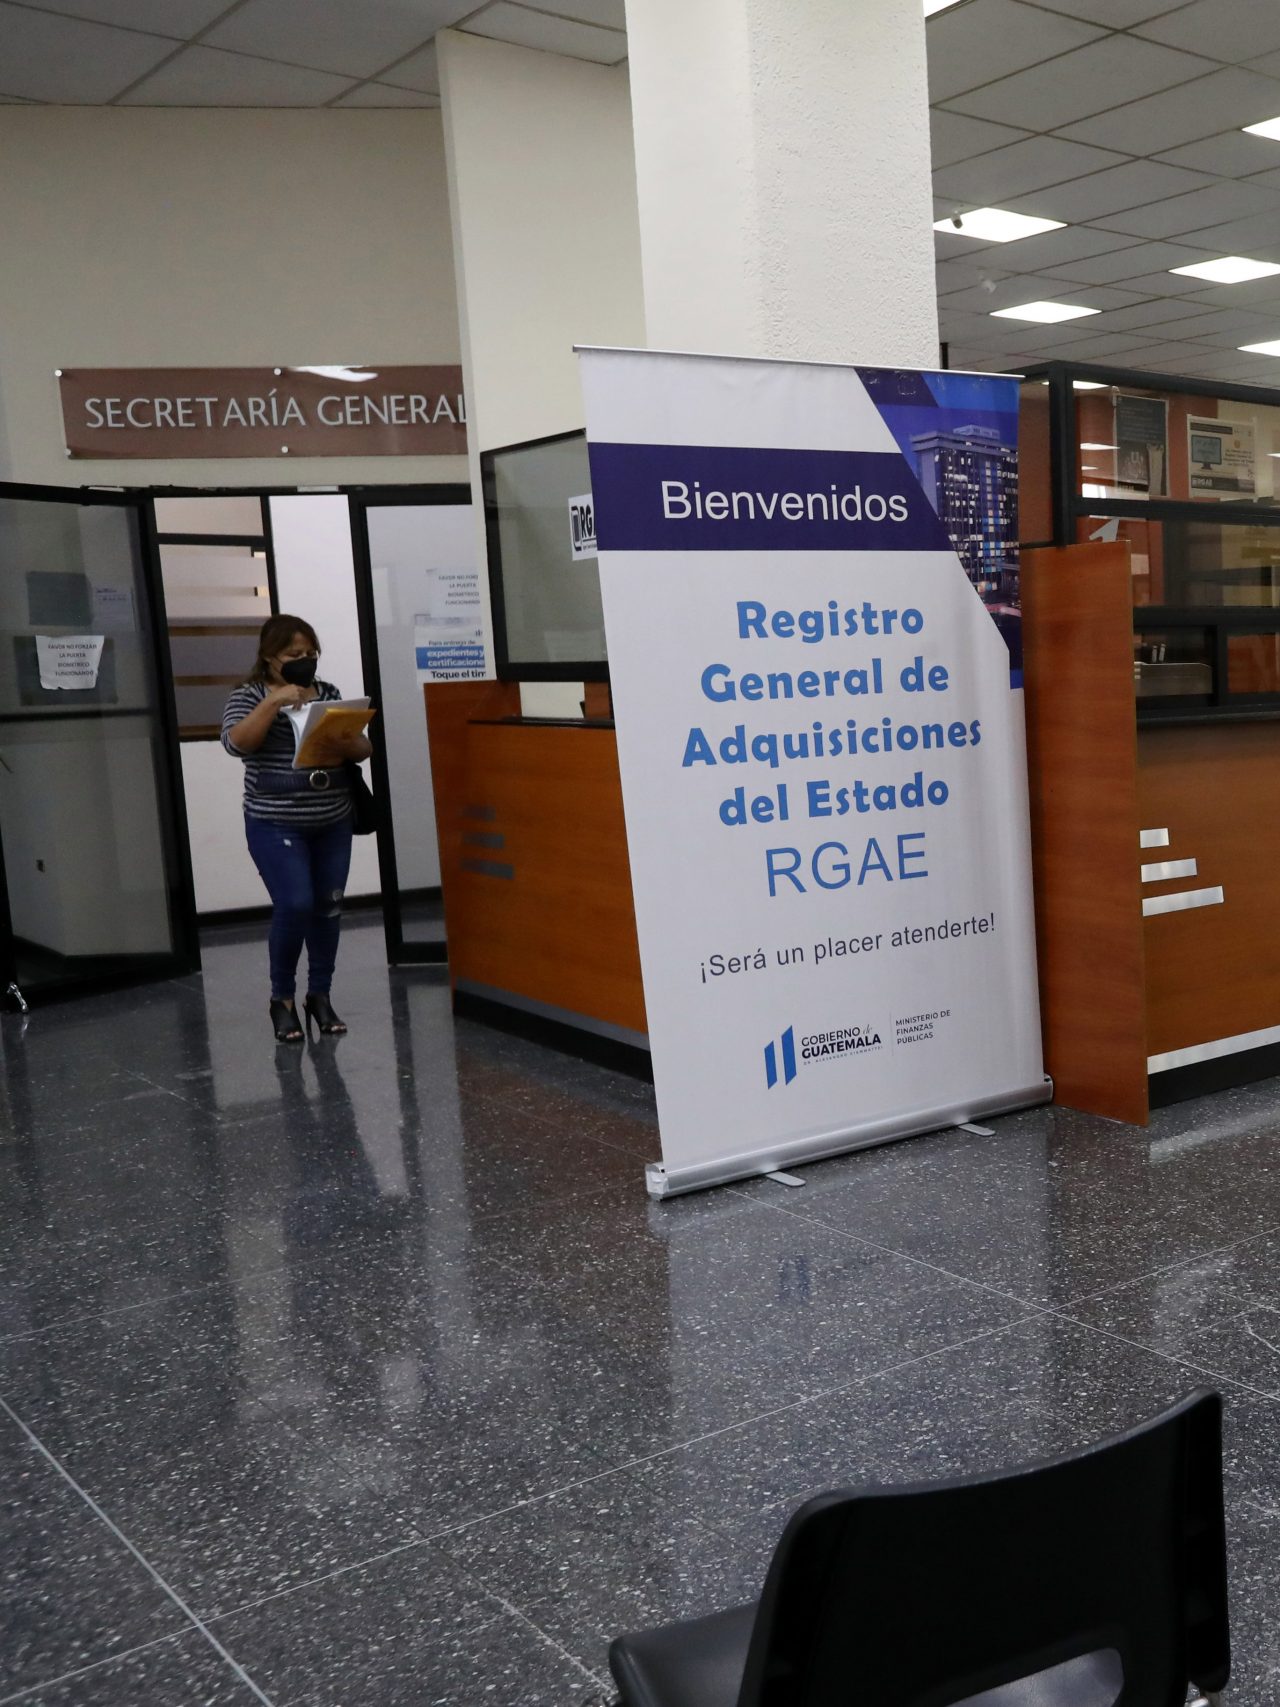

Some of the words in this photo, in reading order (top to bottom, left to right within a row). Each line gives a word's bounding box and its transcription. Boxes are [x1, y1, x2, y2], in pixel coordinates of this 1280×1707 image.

[85, 388, 306, 428] SECRETARÍA
[317, 394, 467, 426] GENERAL
[661, 480, 909, 523] Bienvenidos
[580, 504, 597, 538] RG
[736, 600, 924, 643] Registro
[427, 649, 478, 658] expedientes
[428, 659, 485, 667] certificacione
[431, 670, 460, 680] Toque
[461, 669, 470, 678] el
[701, 658, 884, 703] General
[900, 656, 949, 691] de
[682, 717, 982, 768] Adquisiciones
[719, 784, 789, 826] del
[806, 771, 950, 818] Estado
[765, 832, 929, 897] RGAE
[700, 948, 768, 984] ¡Será
[776, 943, 805, 966] un
[814, 934, 883, 965] placer
[891, 912, 996, 947] atenderte!
[801, 1027, 861, 1047] GOBIERNO
[862, 1024, 873, 1035] de
[895, 1012, 939, 1027] MINISTERIO
[940, 1009, 951, 1017] DE
[896, 1022, 934, 1036] FINANZAS
[801, 1033, 882, 1059] GUATEMALA
